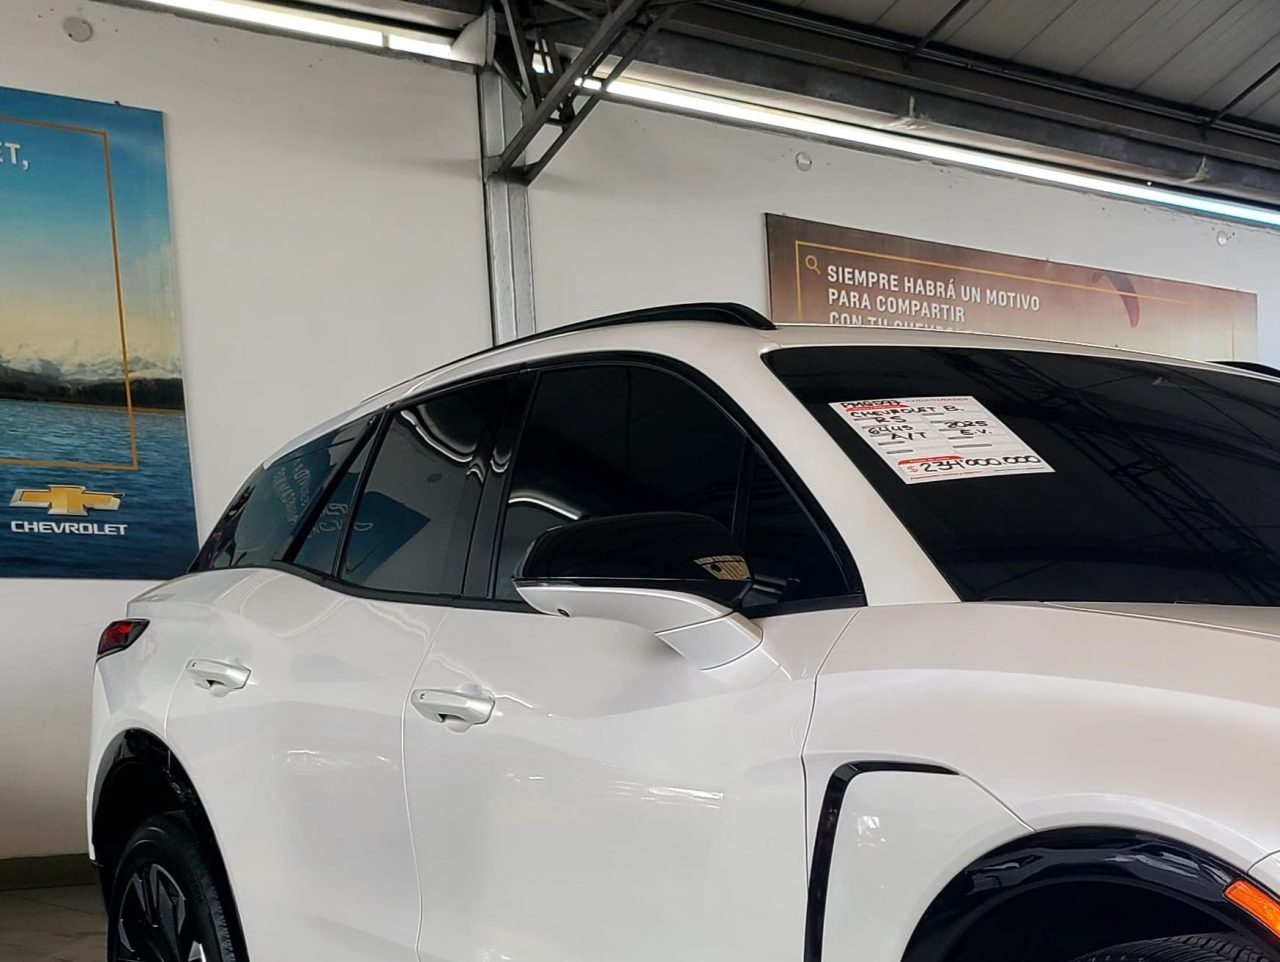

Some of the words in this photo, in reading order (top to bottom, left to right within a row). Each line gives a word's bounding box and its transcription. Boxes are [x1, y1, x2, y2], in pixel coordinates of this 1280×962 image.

[0, 141, 29, 171] T,
[827, 265, 899, 292] SIEMPRE
[904, 277, 957, 299] HABRÁ
[961, 284, 981, 302] UN
[985, 289, 1041, 312] MOTIVO
[828, 288, 871, 312] PARA
[876, 297, 966, 323] COMPARTIR
[829, 312, 862, 326] CON
[944, 420, 988, 428] 2025
[10, 520, 128, 536] CHEVROLET
